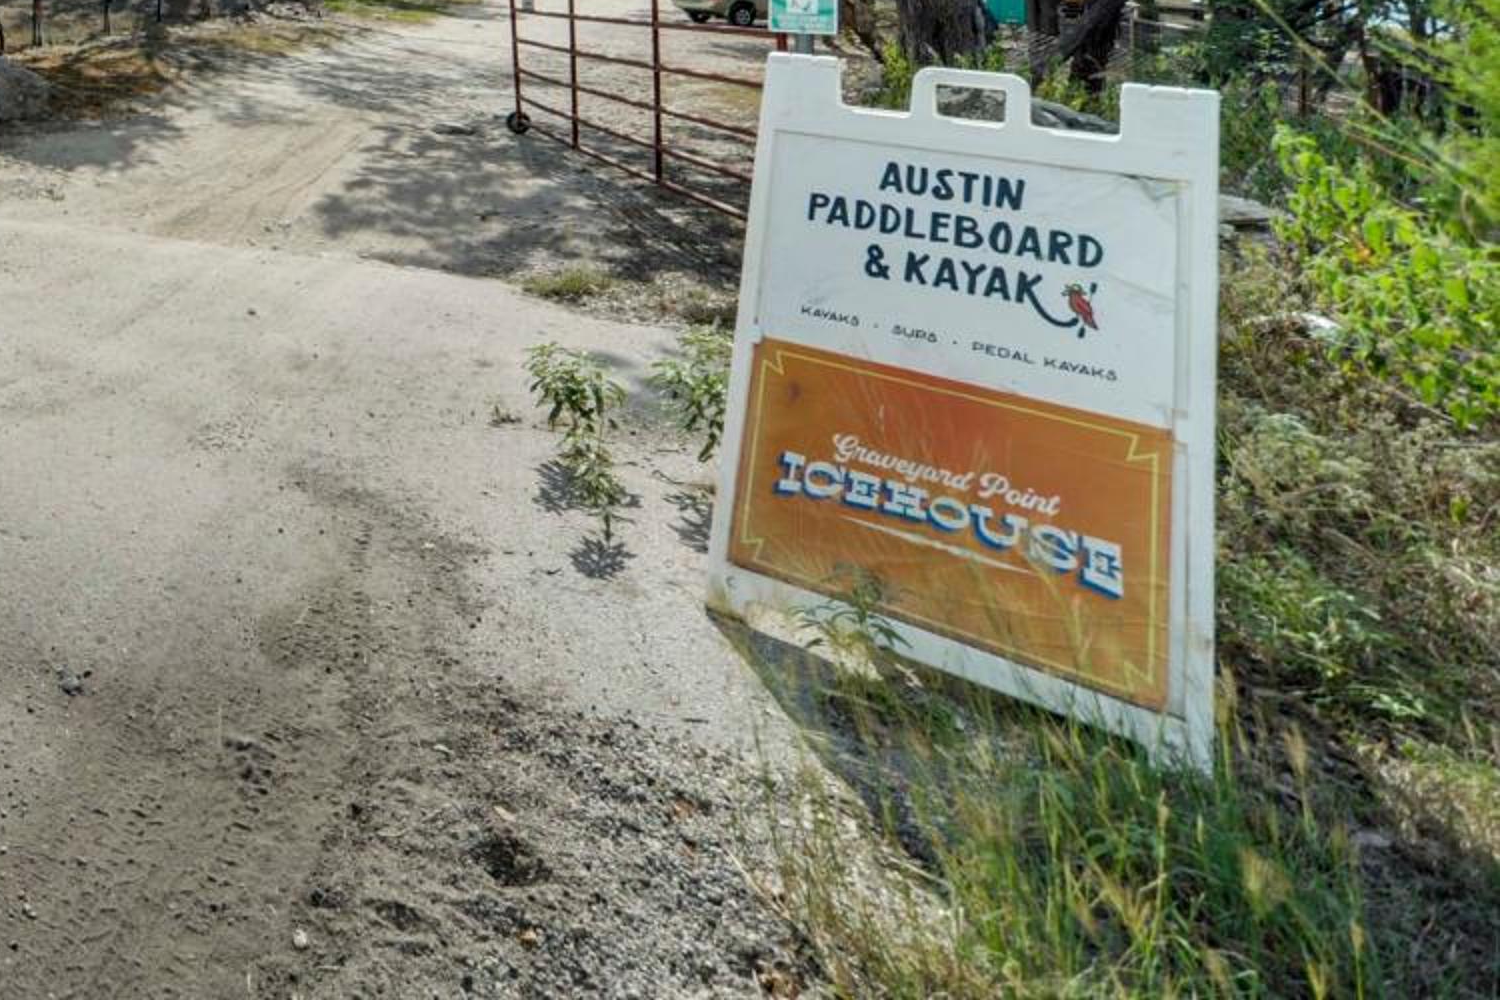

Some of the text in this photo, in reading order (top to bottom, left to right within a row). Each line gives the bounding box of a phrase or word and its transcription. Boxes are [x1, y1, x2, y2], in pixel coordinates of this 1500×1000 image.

[879, 161, 1026, 212] AUSTIN
[808, 193, 1105, 269] PADDLEBOARD
[864, 244, 1077, 327] & KAYAK
[801, 306, 860, 327] KAYAKS
[971, 341, 1034, 365] PEDAL
[1043, 357, 1118, 382] KAYAKS
[832, 432, 1062, 517] Graveyard Point
[775, 451, 1124, 599] ICEHOUSE
